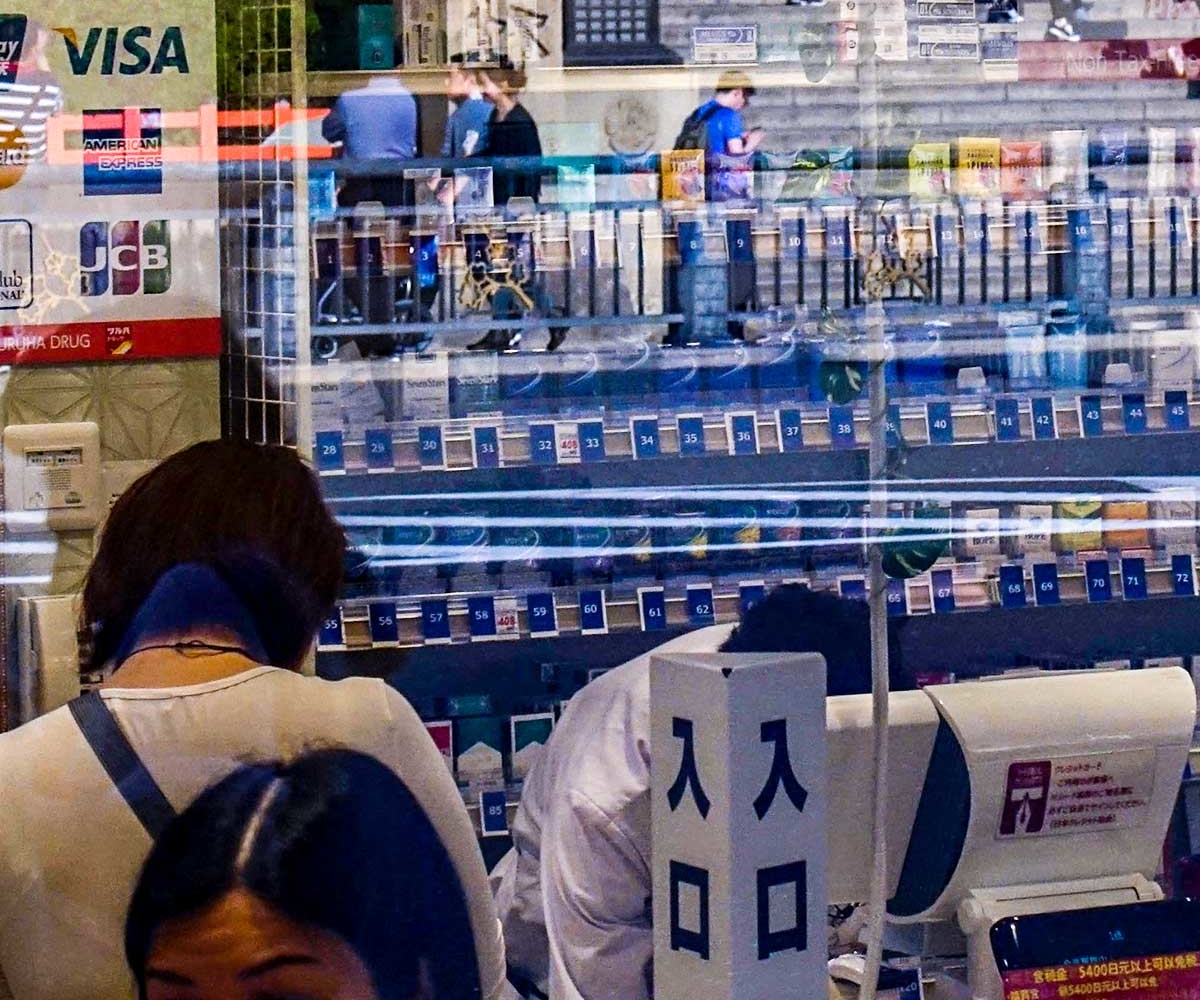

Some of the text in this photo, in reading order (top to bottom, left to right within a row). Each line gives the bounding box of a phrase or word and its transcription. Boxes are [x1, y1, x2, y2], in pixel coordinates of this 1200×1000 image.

[52, 25, 190, 76] VISA
[1067, 55, 1107, 72] Non
[83, 138, 159, 152] AMERICAN
[99, 155, 163, 170] EXPRESS
[1075, 224, 1087, 235] 16
[80, 245, 169, 272] JCB
[50, 333, 91, 349] DRUG
[1086, 410, 1099, 420] 43
[1129, 407, 1143, 418] 44
[1171, 406, 1185, 416] 45
[933, 419, 947, 430] 40
[1000, 417, 1013, 427] 41
[1036, 415, 1049, 426] 42
[785, 426, 799, 436] 37
[837, 423, 851, 434] 38
[640, 435, 654, 446] 34
[684, 433, 698, 444] 35
[737, 431, 751, 442] 36
[423, 440, 437, 451] 30
[481, 443, 495, 453] 31
[538, 440, 552, 450] 32
[585, 438, 599, 448] 33
[322, 445, 337, 455] 28
[1092, 578, 1105, 589] 70
[1127, 576, 1139, 586] 71
[1175, 573, 1189, 584] 72
[1008, 583, 1021, 594] 68
[1041, 581, 1054, 592] 69
[937, 588, 951, 598] 67
[532, 606, 547, 617] 59
[583, 603, 598, 614] 60
[648, 606, 662, 618] 61
[695, 604, 710, 615] 62
[429, 612, 443, 623] 57
[474, 609, 489, 620] 58
[378, 615, 393, 626] 56
[488, 805, 502, 816] 85
[666, 716, 711, 961] 入口
[752, 718, 808, 961] 入口
